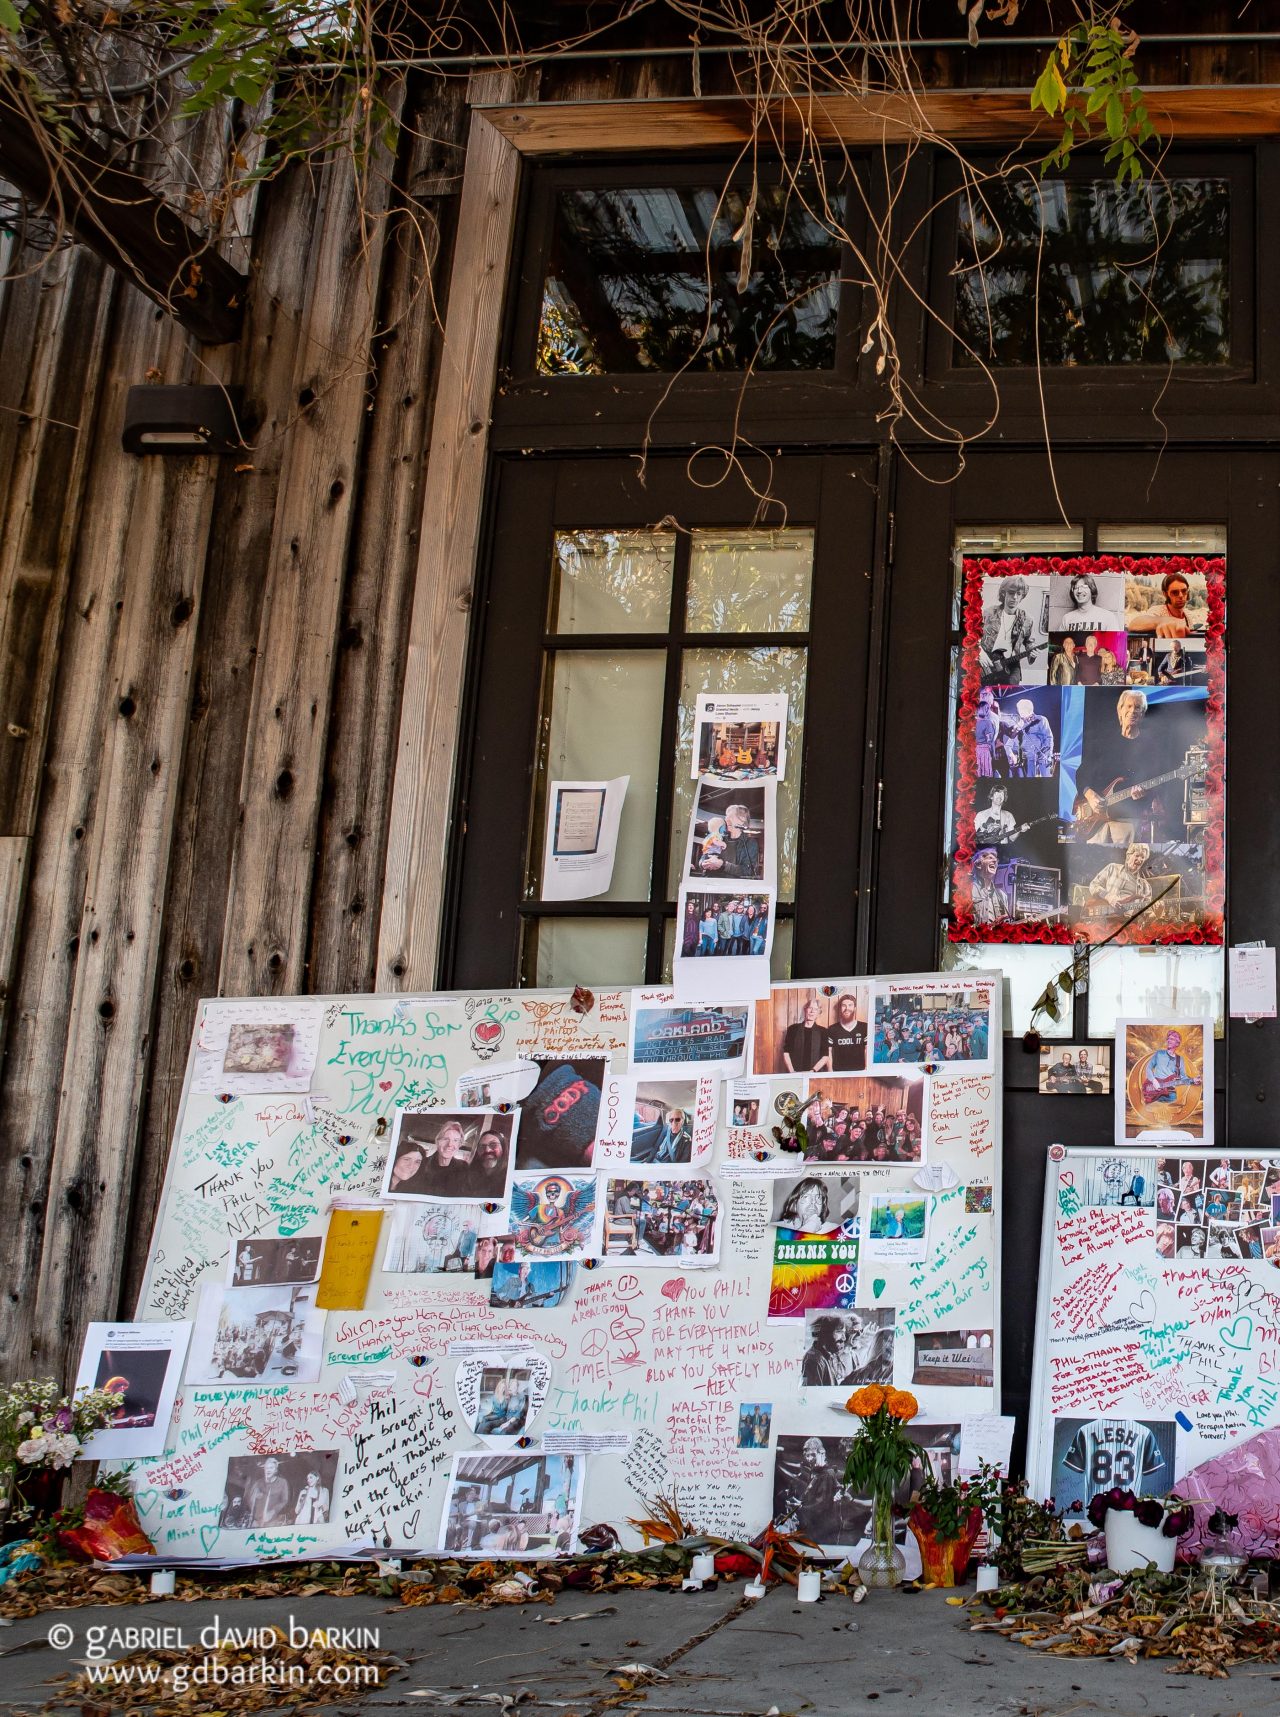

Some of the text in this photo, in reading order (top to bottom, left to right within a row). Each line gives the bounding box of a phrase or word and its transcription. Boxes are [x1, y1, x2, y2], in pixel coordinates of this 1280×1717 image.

[341, 1012, 462, 1040] Thanks for
[931, 1107, 982, 1119] Greatest Crew
[777, 1244, 856, 1260] THANK YOU
[1162, 1265, 1250, 1286] thank you
[682, 1283, 709, 1300] YOU
[653, 1304, 696, 1321] THANK
[654, 1347, 682, 1361] MAY
[687, 1343, 714, 1358] THE
[739, 1343, 774, 1354] WINDS
[922, 1354, 942, 1364] Keep
[943, 1354, 949, 1363] it
[1084, 1346, 1121, 1359] THANK
[646, 1368, 676, 1382] BLOW
[682, 1365, 704, 1378] YOU
[712, 1360, 760, 1378] SAFELY
[1075, 1361, 1110, 1374] BEING
[1113, 1354, 1136, 1364] THE
[554, 1388, 658, 1424] Thanks Phil
[382, 1407, 422, 1435] brought
[667, 1415, 711, 1427] grateful
[690, 1425, 710, 1435] Phil
[1091, 1427, 1140, 1447] LESH
[344, 1457, 369, 1475] love
[377, 1441, 396, 1459] and
[401, 1422, 434, 1446] magic
[342, 1484, 354, 1497] so
[443, 1425, 457, 1440] for
[1092, 1450, 1135, 1486] 83
[344, 1500, 362, 1518] all
[368, 1486, 389, 1502] the
[394, 1463, 427, 1495] years
